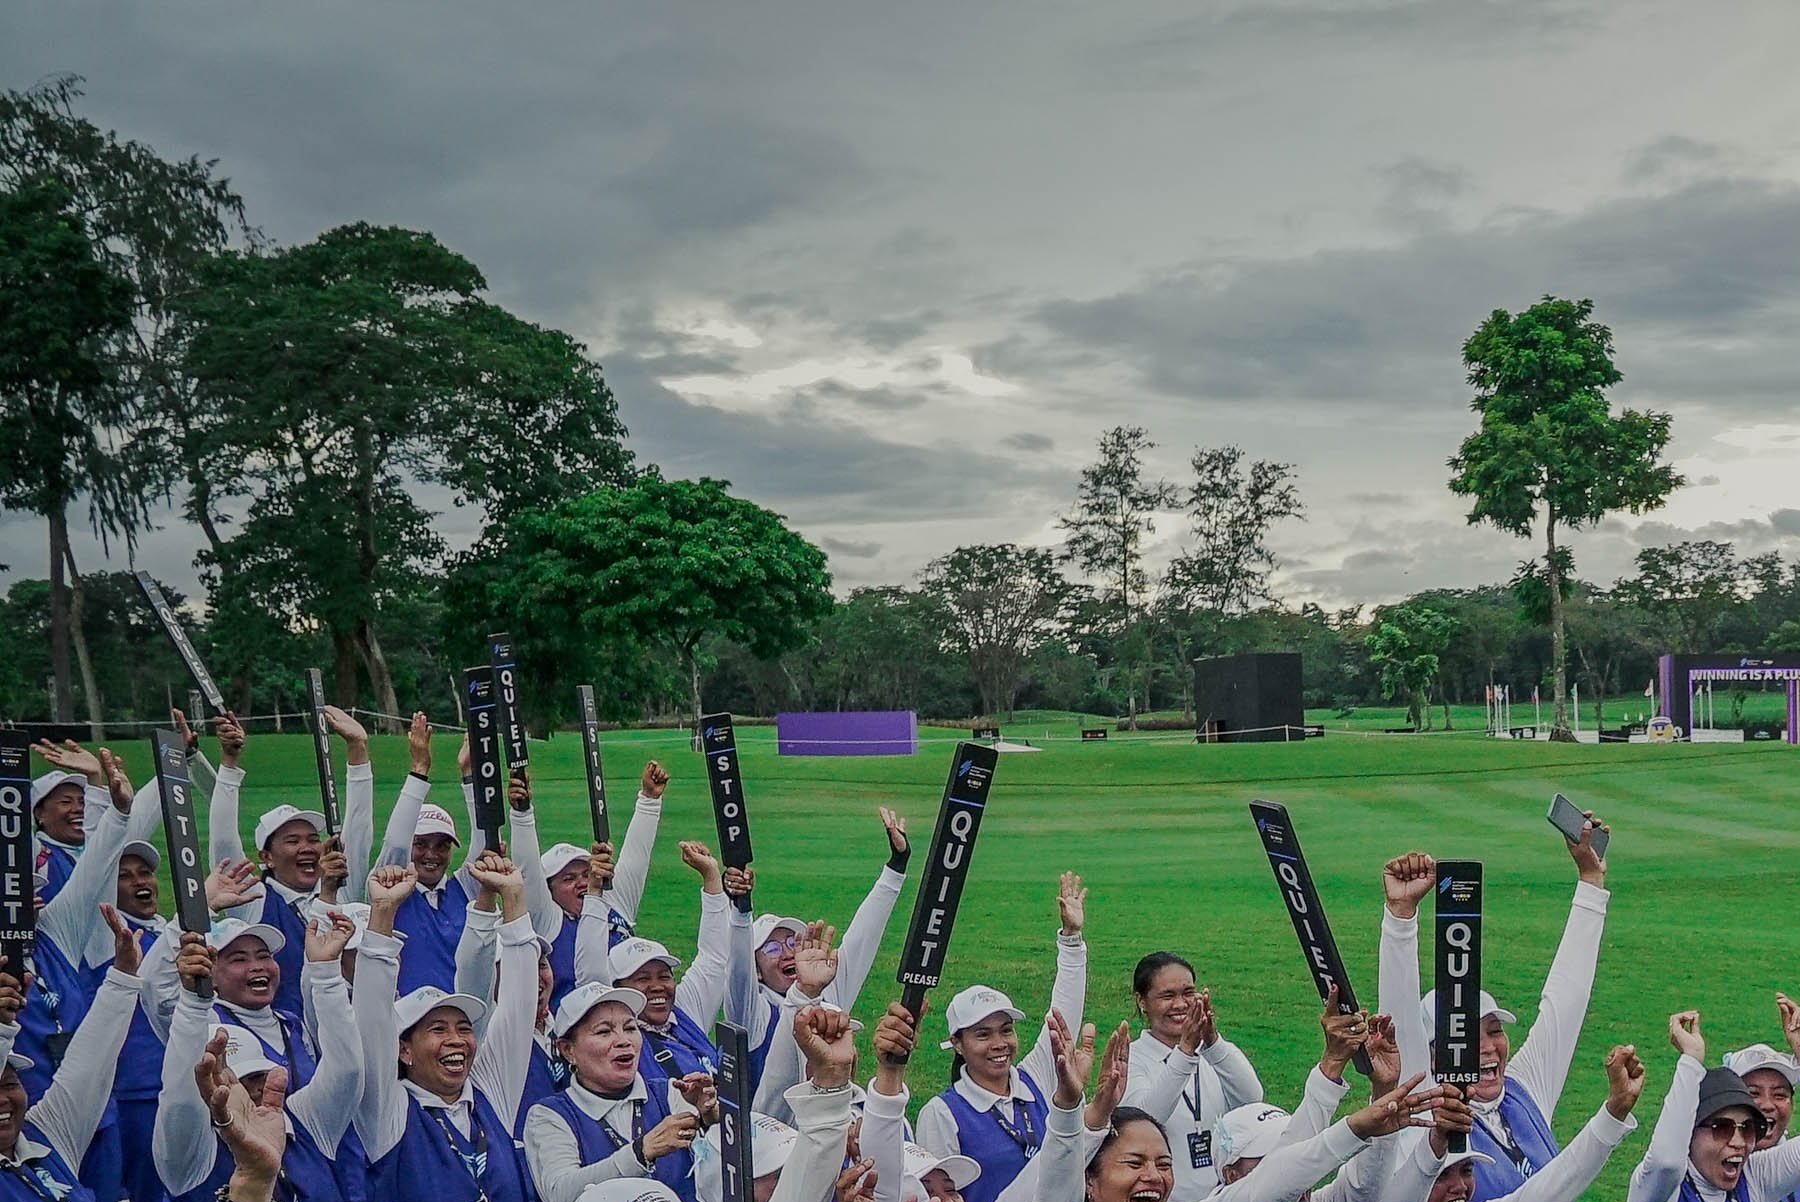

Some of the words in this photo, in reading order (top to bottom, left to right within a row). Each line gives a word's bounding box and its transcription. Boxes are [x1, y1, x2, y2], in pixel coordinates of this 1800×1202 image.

[160, 607, 214, 694] QUIET
[1691, 669, 1747, 681] WINNING
[1749, 669, 1763, 681] IS
[1763, 669, 1773, 681] A
[478, 712, 495, 803] STOP
[501, 670, 522, 758] QUIET
[319, 712, 337, 821] QUIET
[589, 727, 604, 815] STOP
[717, 756, 740, 841] STOP
[0, 786, 22, 924] QUIET
[173, 785, 198, 898] STOP
[921, 810, 973, 967] QUIET
[1278, 862, 1335, 991] QUIET
[0, 930, 34, 940] LEASE
[903, 972, 938, 987] PLEASE
[1445, 922, 1472, 1067] QUIET
[1436, 1072, 1479, 1083] PLEASE
